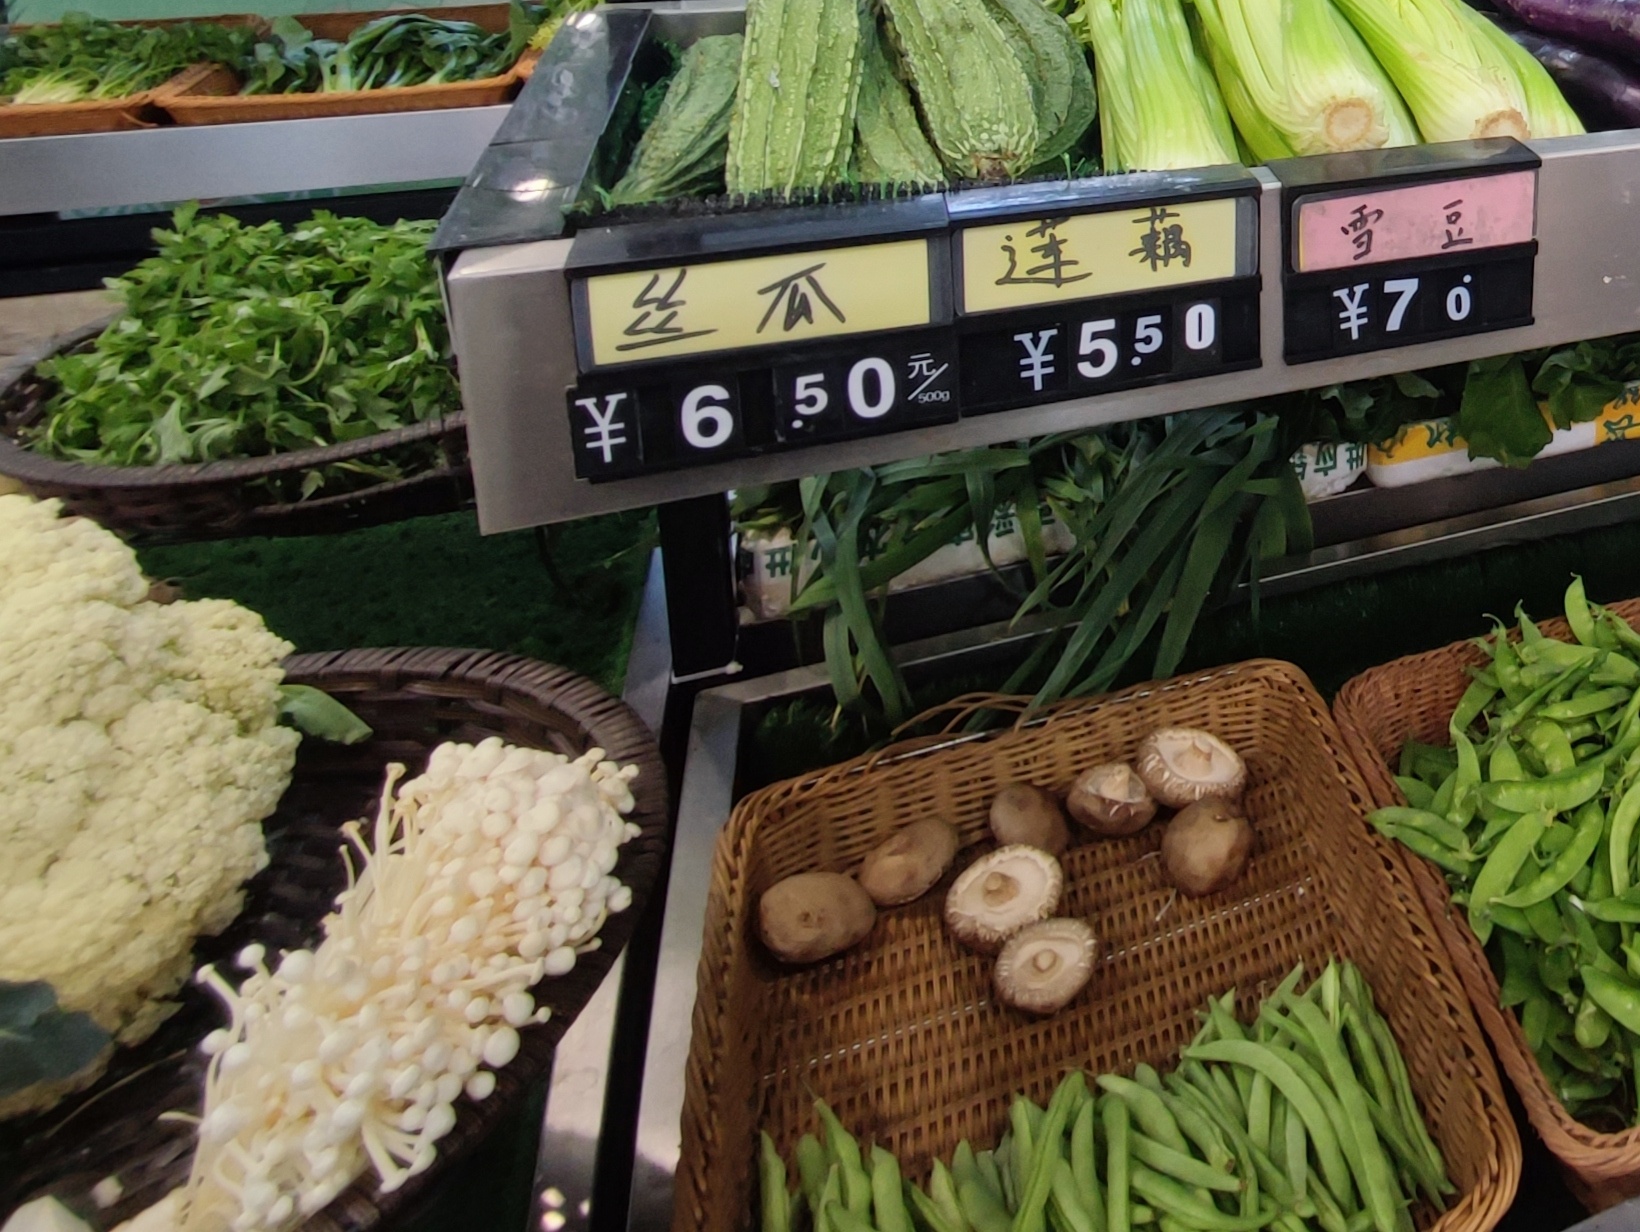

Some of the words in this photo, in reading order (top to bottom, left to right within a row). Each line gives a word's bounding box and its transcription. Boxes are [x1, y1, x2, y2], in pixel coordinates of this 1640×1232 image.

[995, 206, 1193, 288] 莲藕
[1340, 199, 1473, 261] 雪豆
[615, 262, 846, 352] 丝瓜
